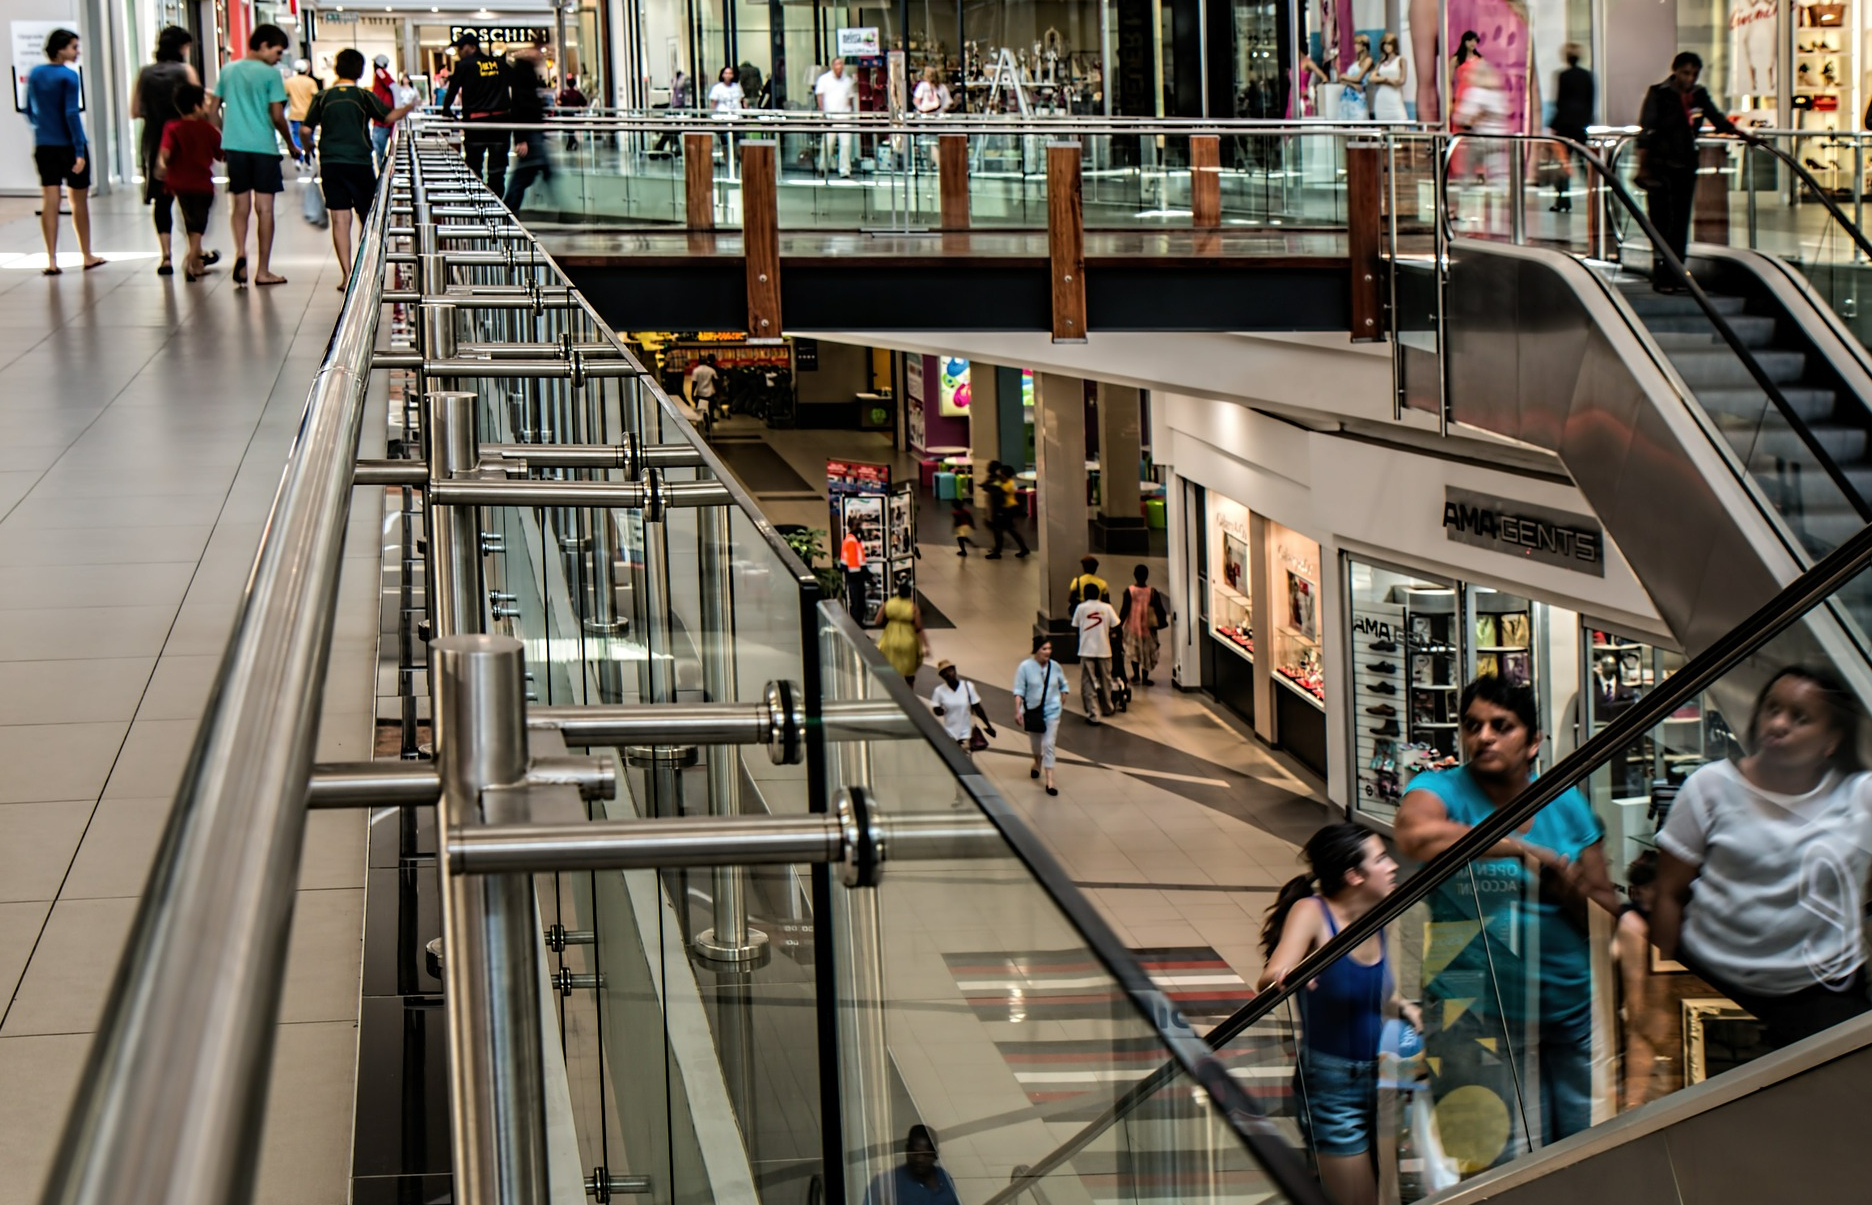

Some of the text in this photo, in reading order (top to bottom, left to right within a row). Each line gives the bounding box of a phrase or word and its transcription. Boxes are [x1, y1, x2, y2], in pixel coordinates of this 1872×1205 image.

[1443, 501, 1596, 562] AMA GENTS
[1354, 617, 1391, 641] AMA
